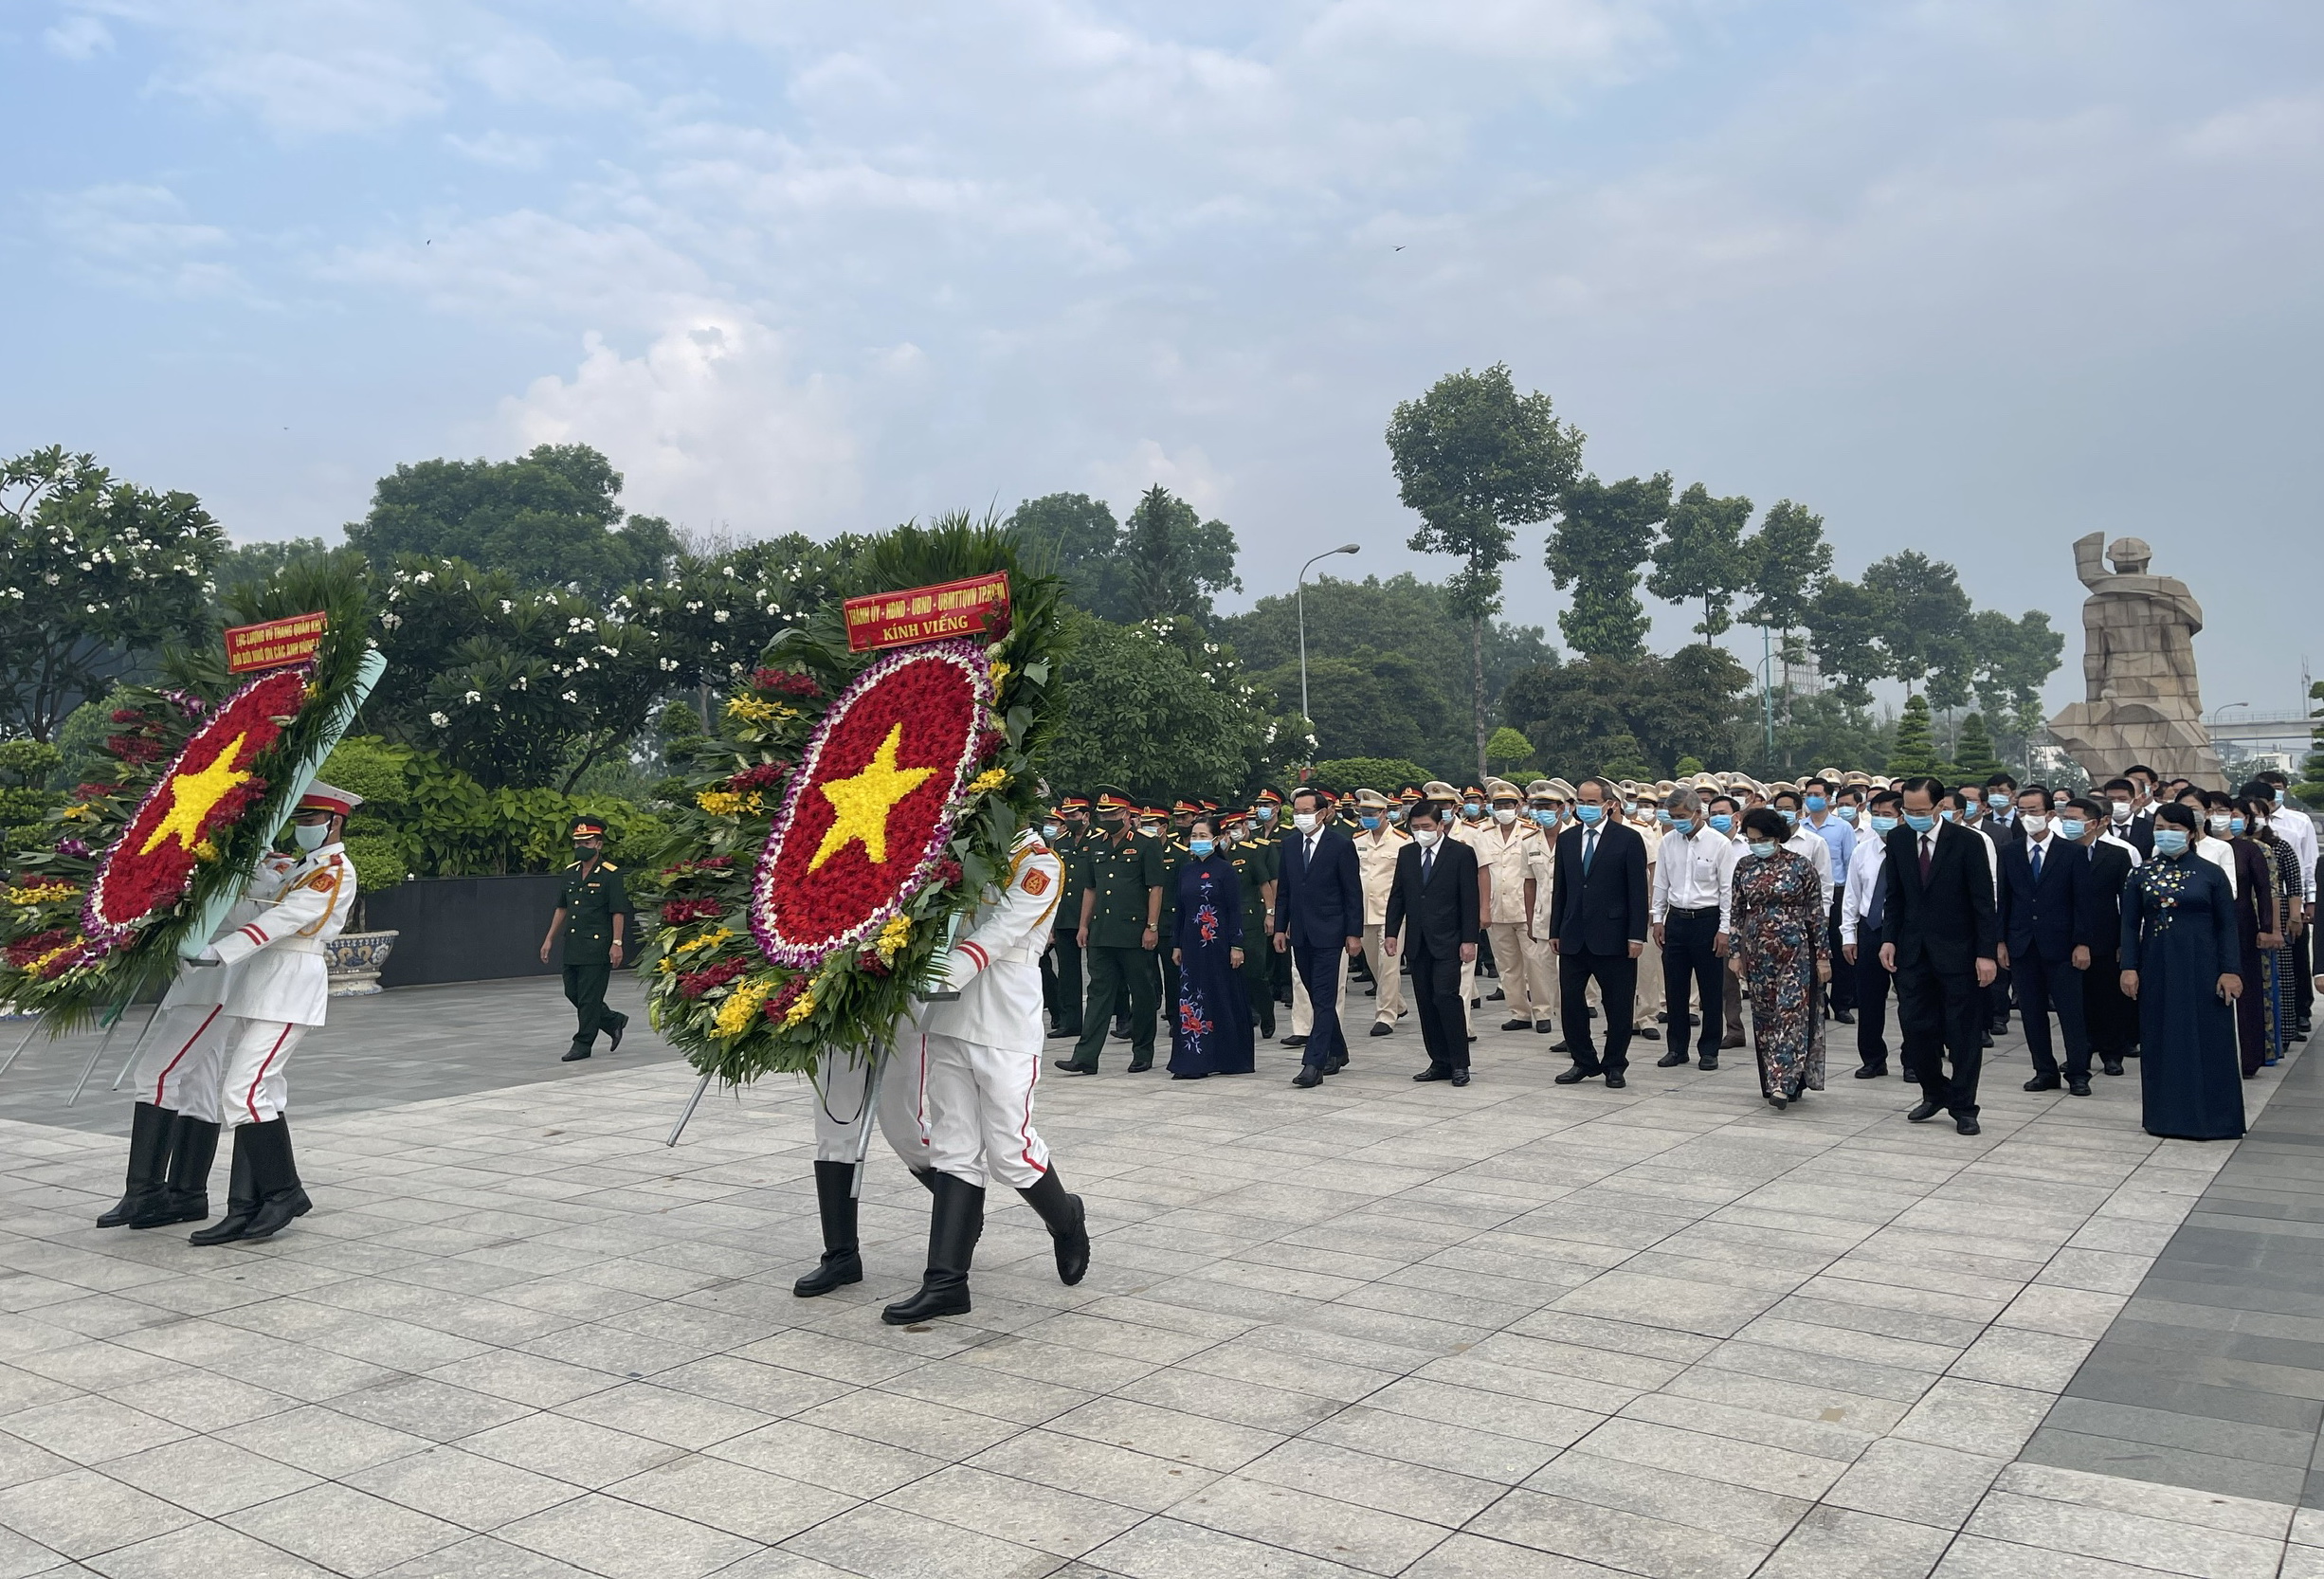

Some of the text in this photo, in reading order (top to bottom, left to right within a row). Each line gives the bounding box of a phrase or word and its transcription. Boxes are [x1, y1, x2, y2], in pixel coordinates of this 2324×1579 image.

[848, 605, 870, 626] THÀNH
[871, 599, 880, 623] ỦY
[912, 595, 932, 616] UBND
[938, 588, 976, 611] UBMTTQVN
[274, 625, 293, 639] TRANG
[883, 613, 968, 641] KÍNH VIẾNG
[274, 644, 285, 659] CÁC
[286, 643, 299, 656] ANH
